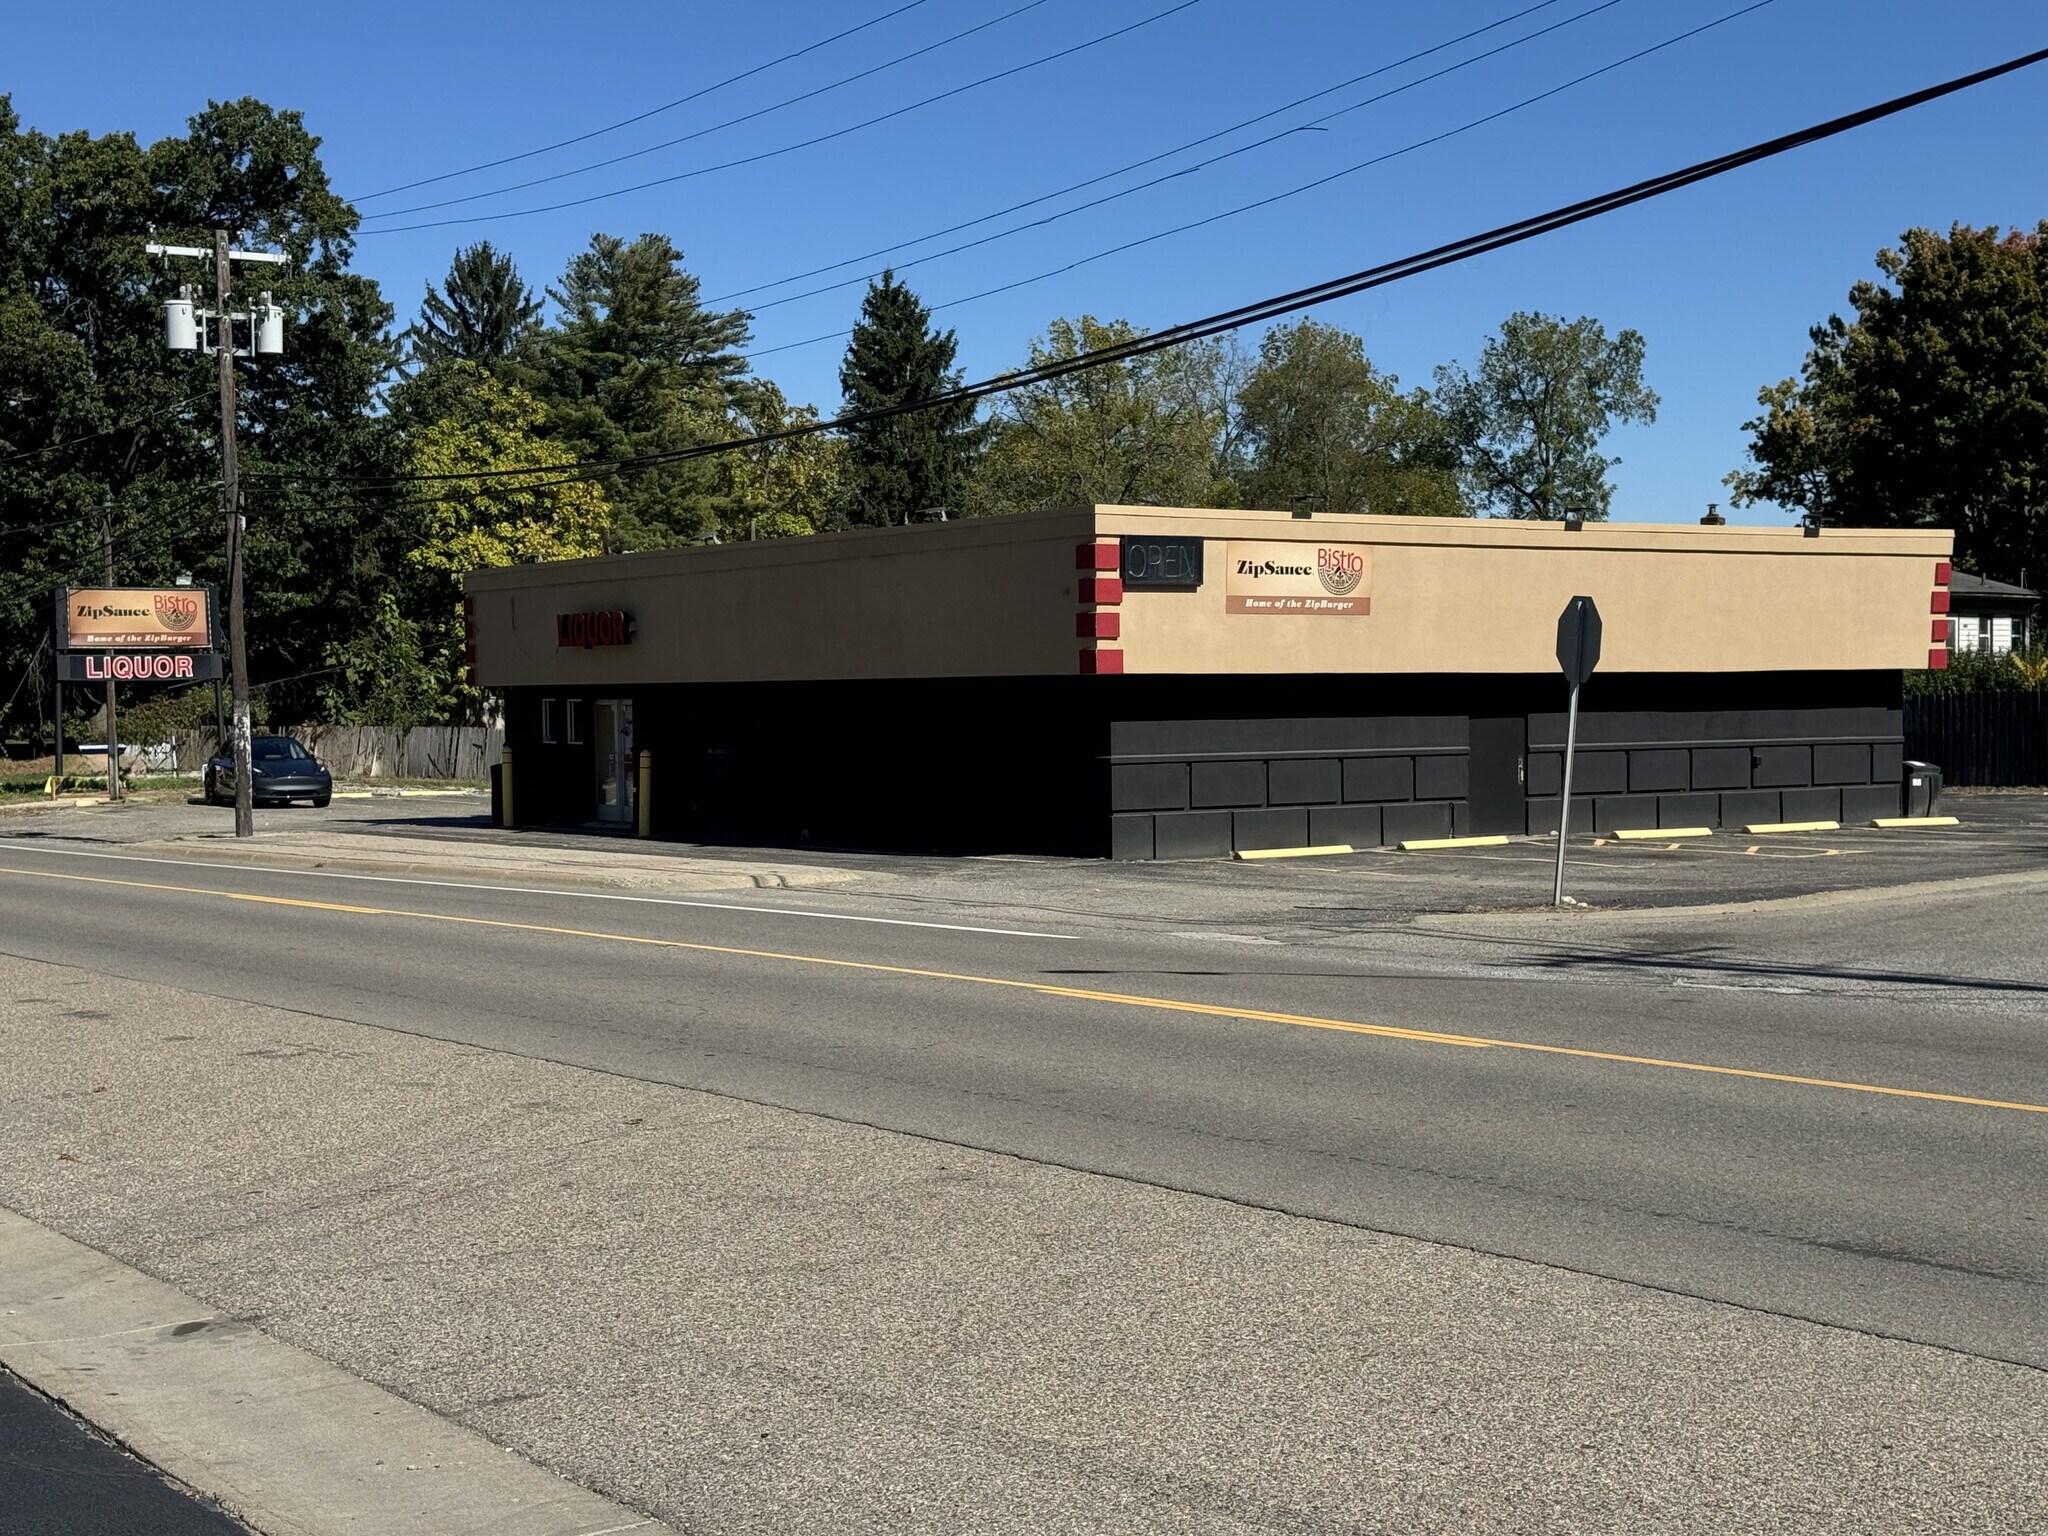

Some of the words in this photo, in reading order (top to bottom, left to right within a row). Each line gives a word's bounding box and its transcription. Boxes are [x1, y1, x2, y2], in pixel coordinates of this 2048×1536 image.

[1128, 544, 1196, 578] OPEN
[1236, 559, 1312, 578] ZipSauce
[1317, 548, 1363, 573] Bistro
[76, 605, 150, 619] ZipSauce
[153, 595, 197, 613] Bistro
[1245, 598, 1272, 608] Home
[1274, 600, 1286, 611] of
[1286, 600, 1302, 608] the
[1304, 600, 1354, 611] ZipBurger
[86, 634, 113, 643] Home
[115, 634, 126, 644] of
[126, 634, 142, 642] the
[143, 634, 192, 644] ZipBurger
[556, 611, 625, 647] LIQUOR
[86, 656, 193, 679] LIQUOR
